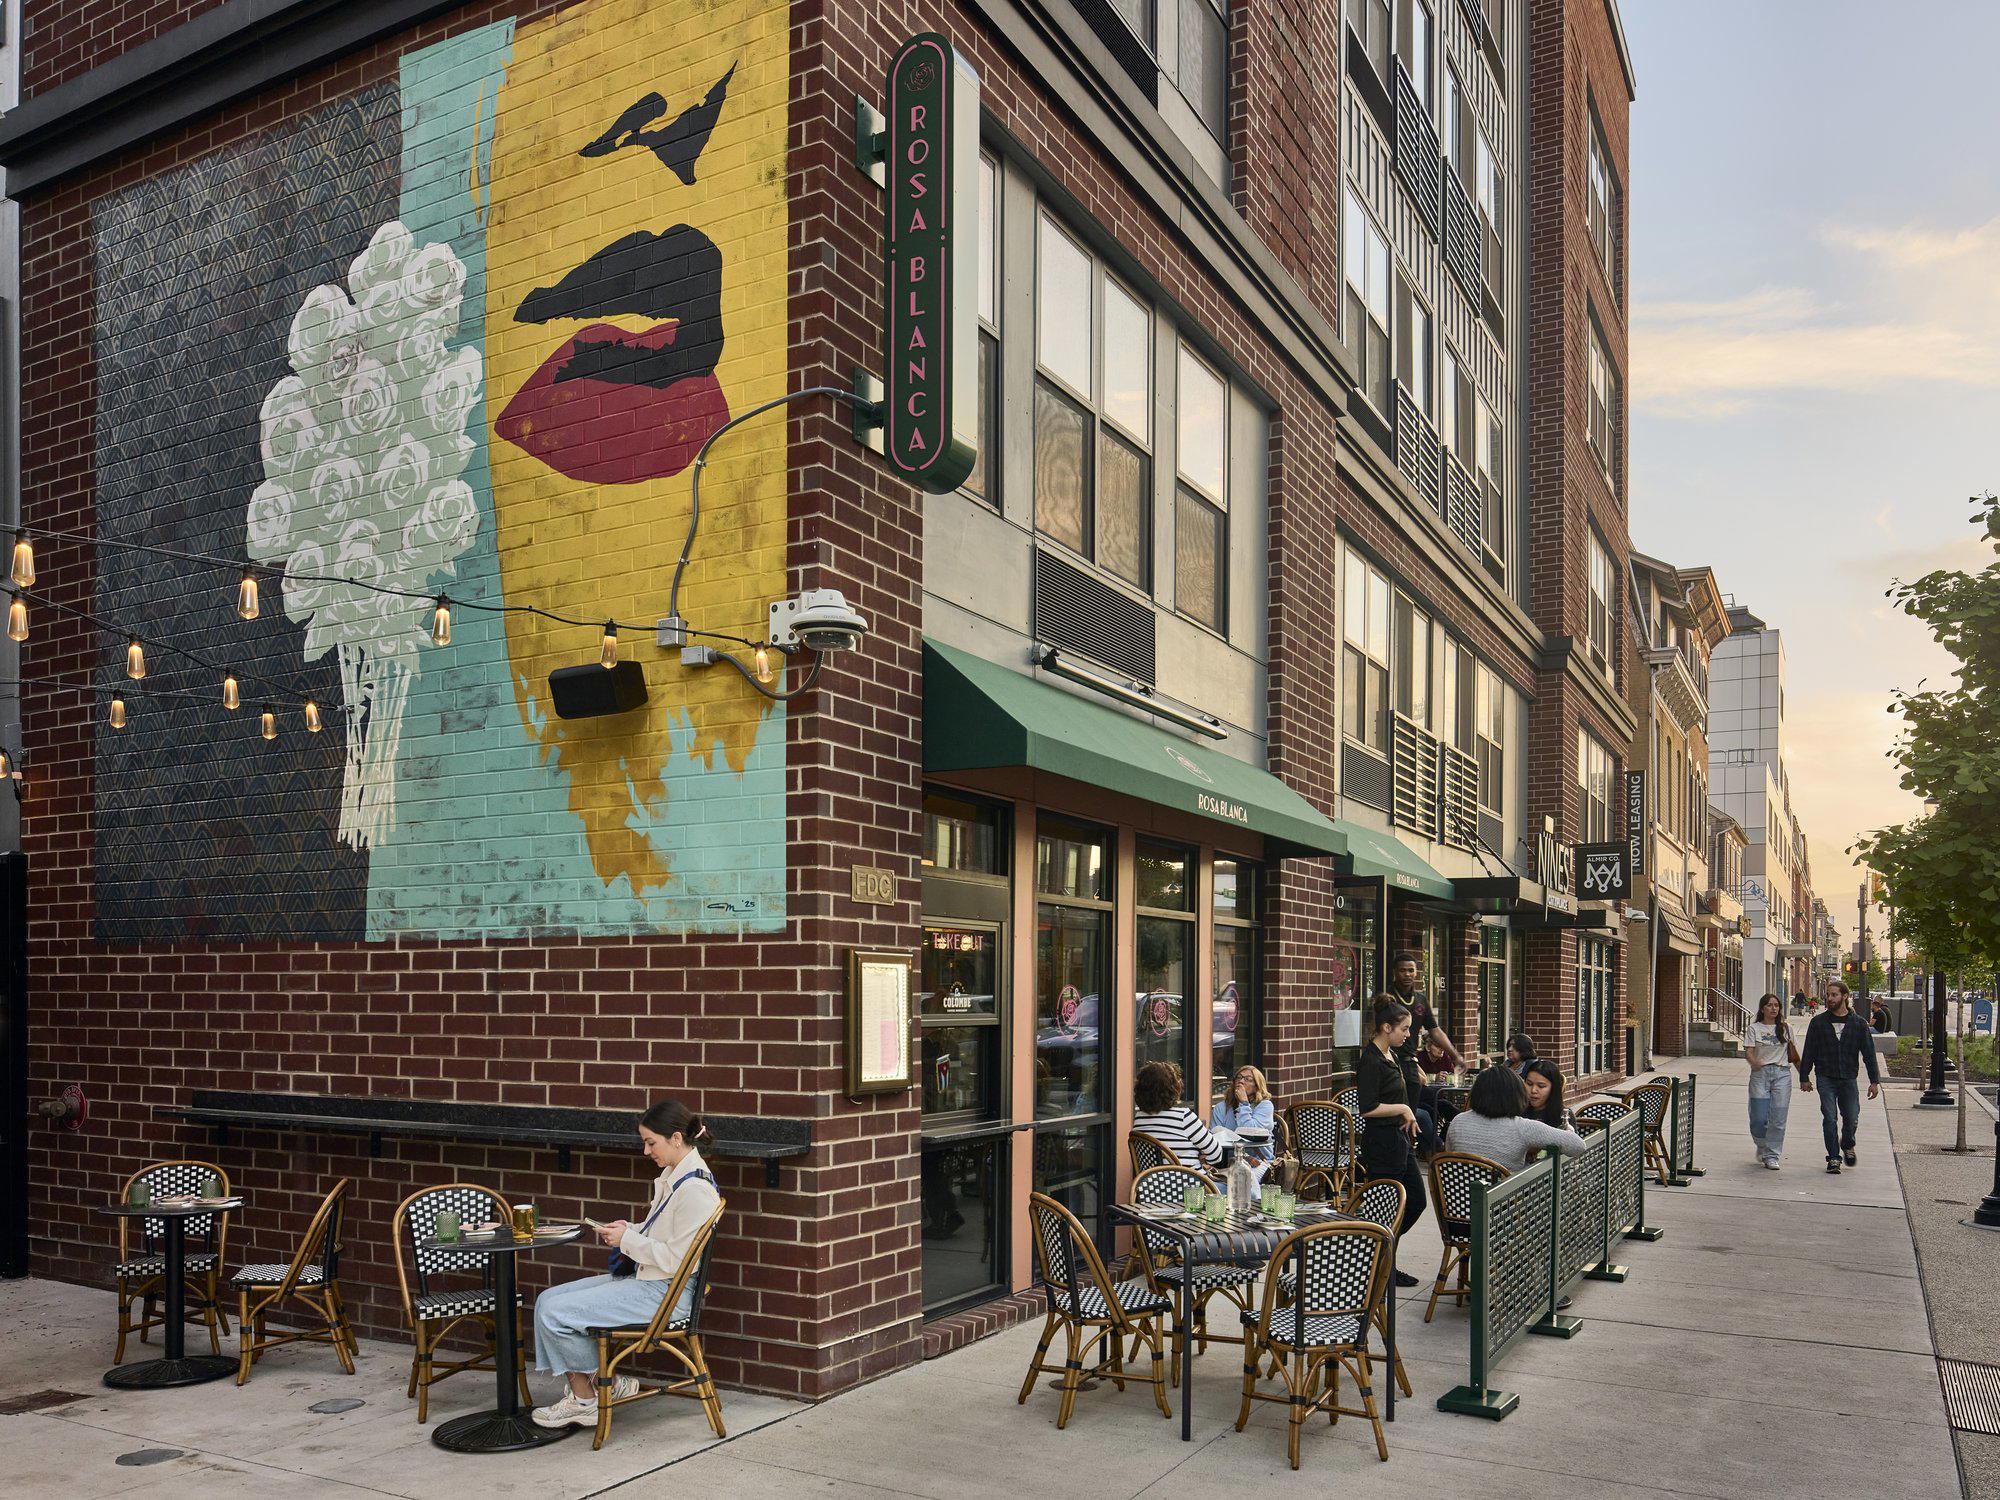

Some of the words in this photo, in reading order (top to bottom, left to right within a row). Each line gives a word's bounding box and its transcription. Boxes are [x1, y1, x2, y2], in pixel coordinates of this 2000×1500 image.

[907, 105, 929, 233] ROSA
[907, 256, 927, 452] BLANCA
[1198, 793, 1219, 815] ROSA
[1220, 800, 1248, 823] BLANCA
[1630, 775, 1641, 830] LEASING
[1631, 834, 1641, 867] NOW
[855, 871, 892, 899] FDC
[932, 932, 984, 951] TAKEOUT
[943, 997, 972, 1008] COLOMBE
